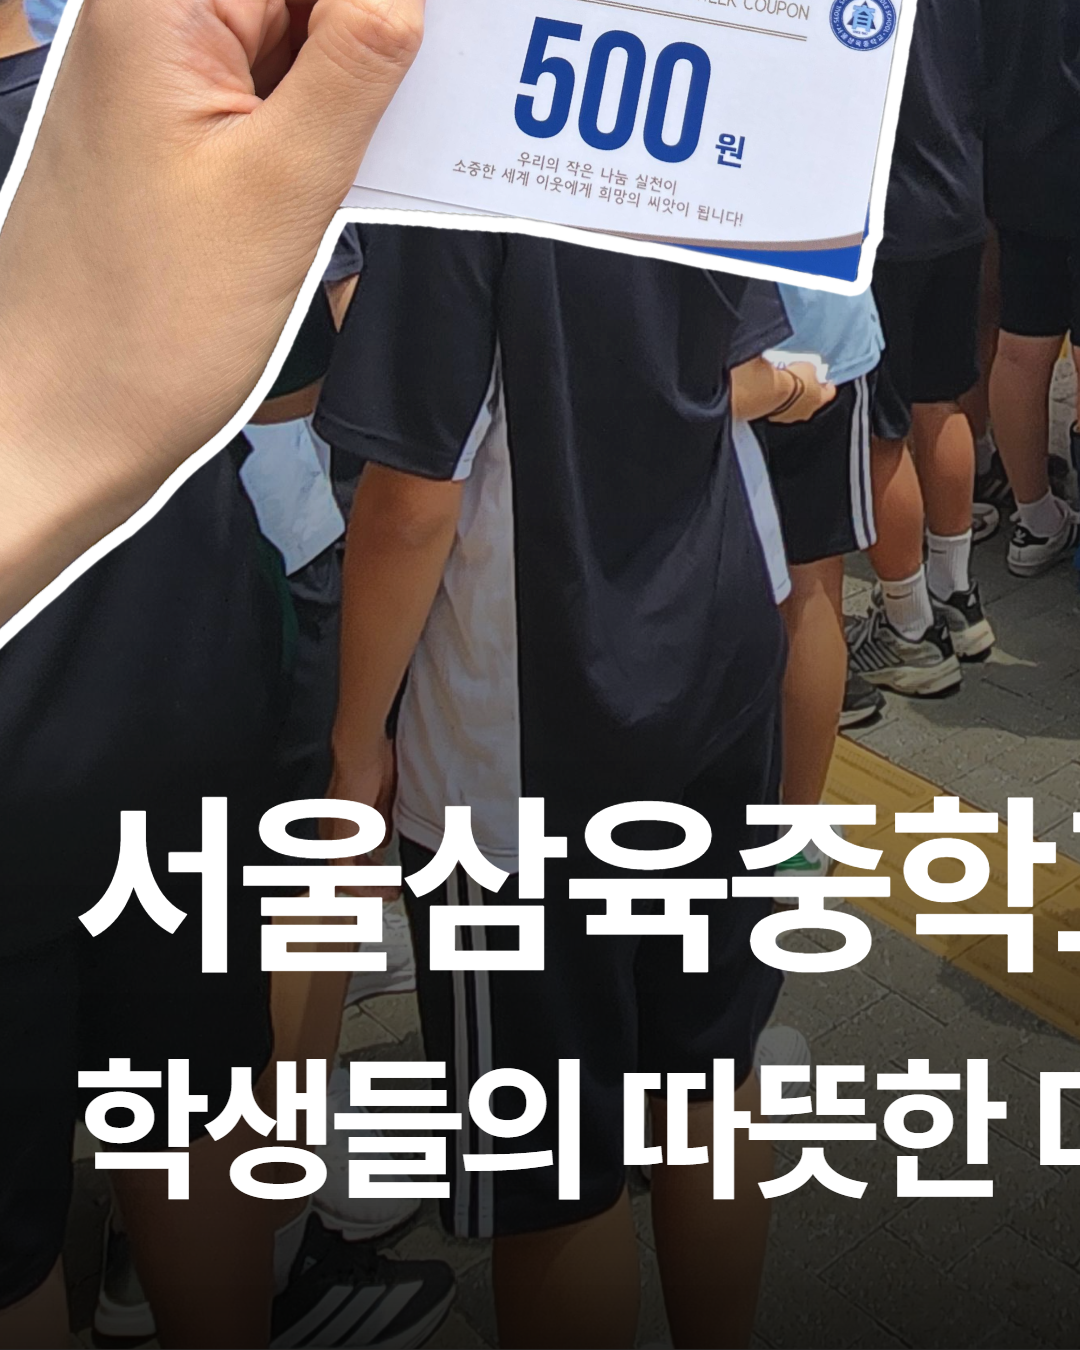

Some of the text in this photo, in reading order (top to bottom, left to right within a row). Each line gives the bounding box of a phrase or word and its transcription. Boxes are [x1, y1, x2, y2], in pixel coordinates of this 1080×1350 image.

[514, 16, 746, 169] 500 원
[452, 158, 744, 227] 소중한 세계 이웃에게 희망의 씨앗이 됩니다!
[517, 151, 677, 196] 우리의 작은 나눔 실천이
